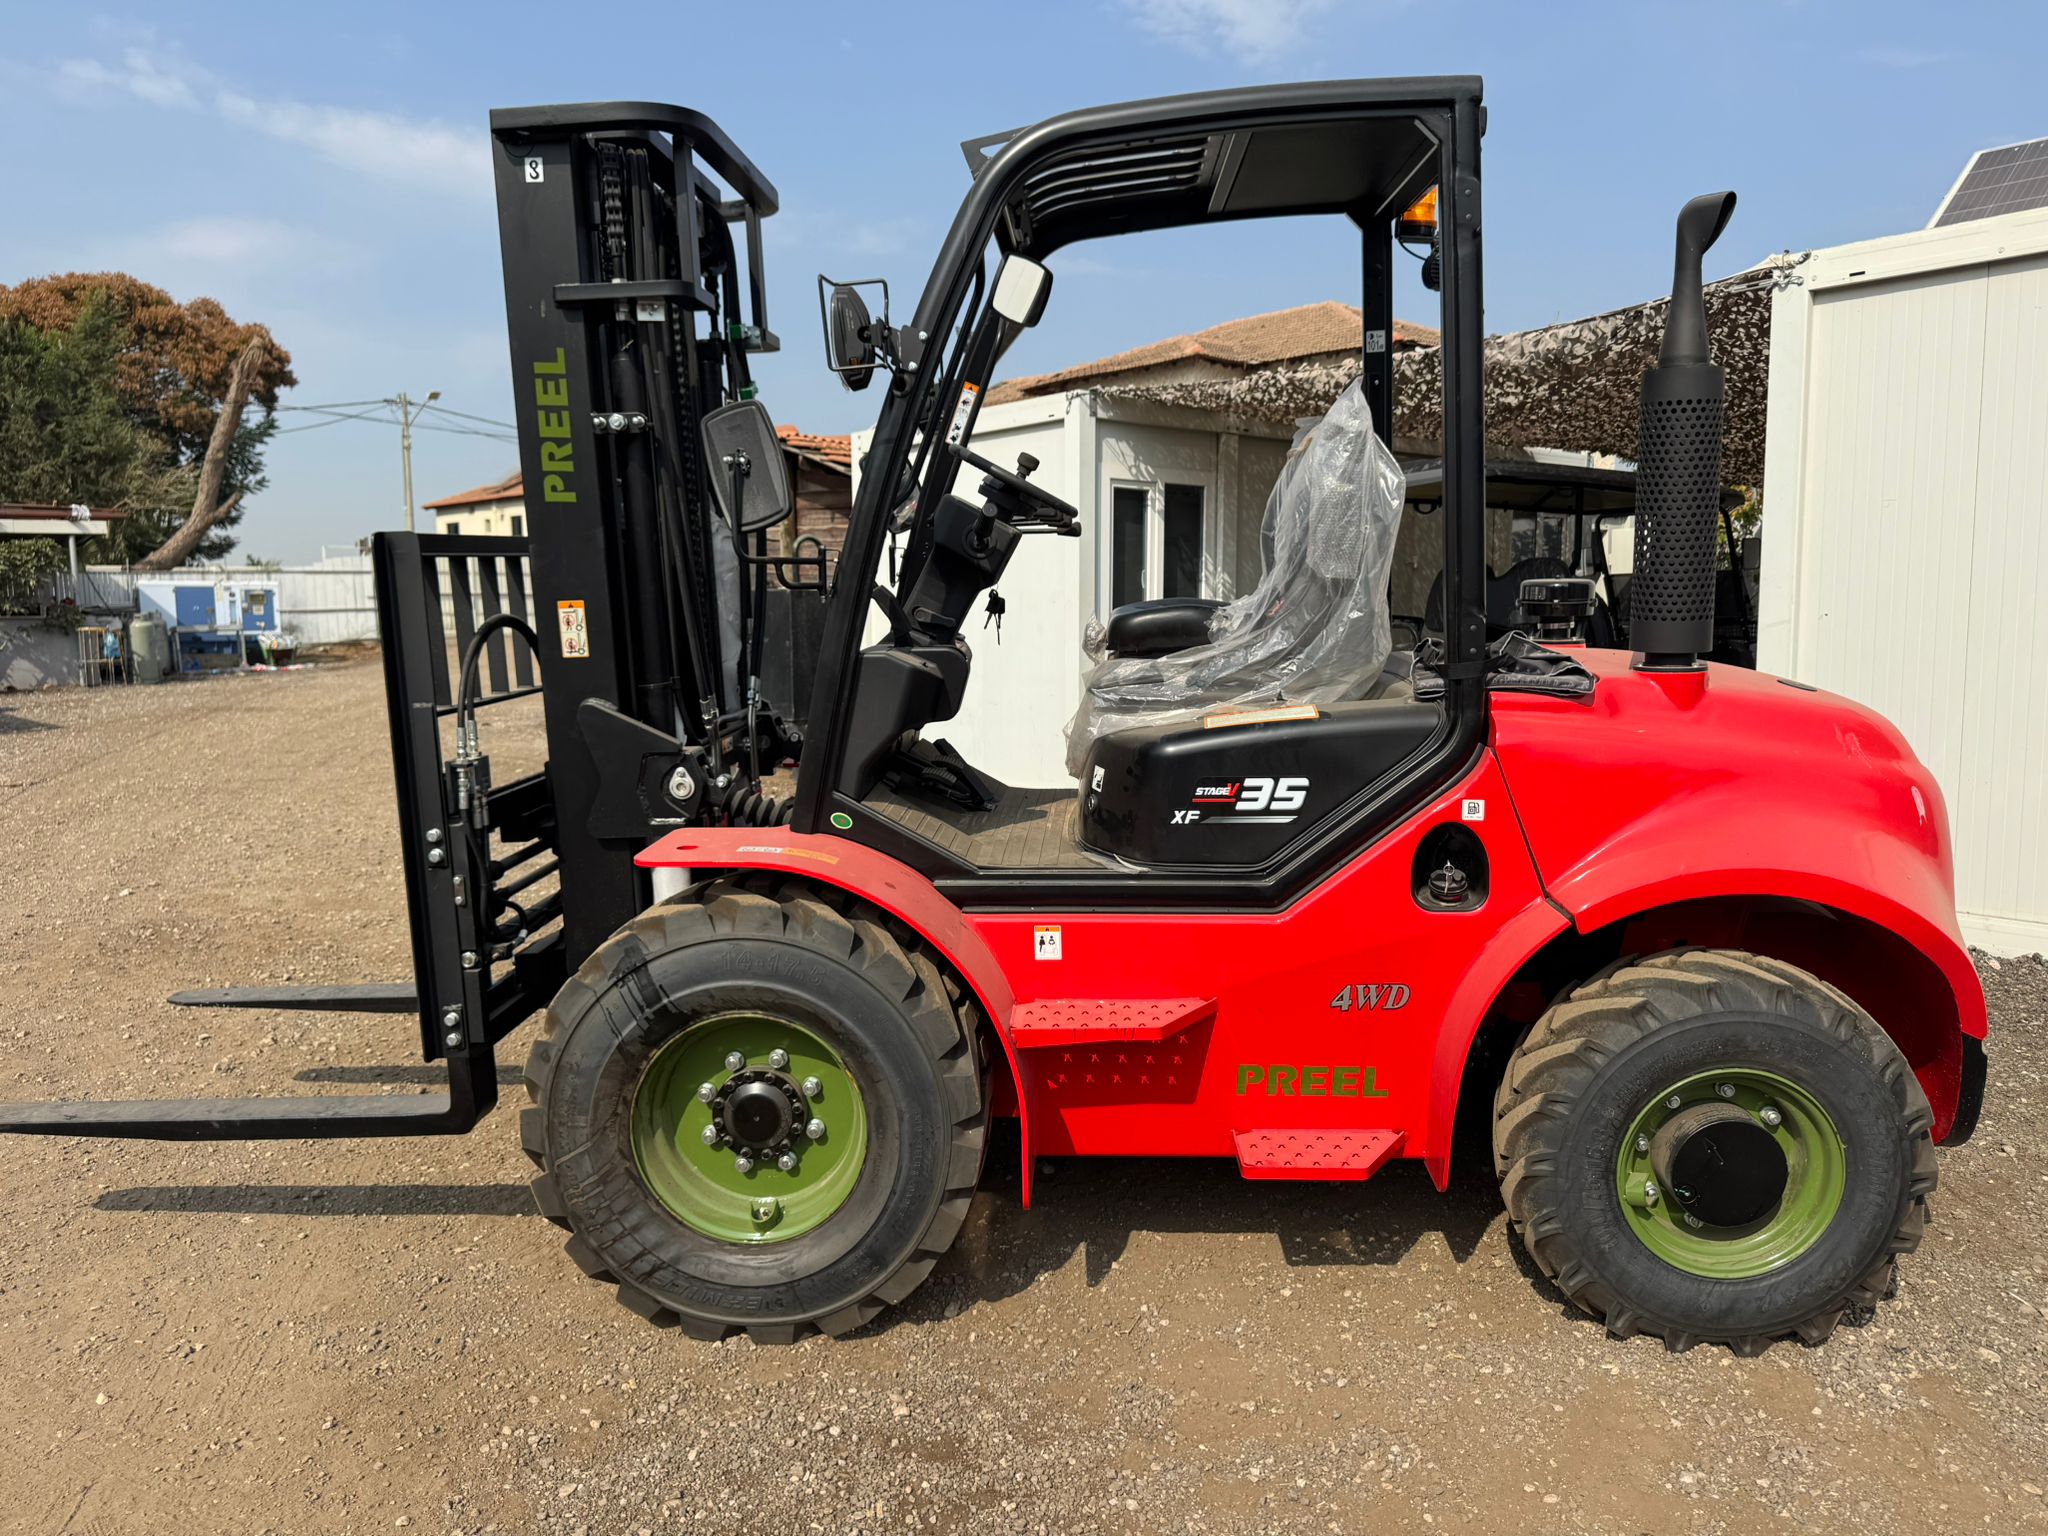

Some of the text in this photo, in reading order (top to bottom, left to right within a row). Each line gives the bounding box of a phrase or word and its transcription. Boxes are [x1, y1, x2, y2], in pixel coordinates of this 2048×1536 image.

[533, 347, 576, 502] PREEL
[1235, 777, 1310, 811] 35
[1170, 810, 1200, 825] XF
[1330, 983, 1411, 1012] 4WD
[1236, 1064, 1389, 1098] PREEL
